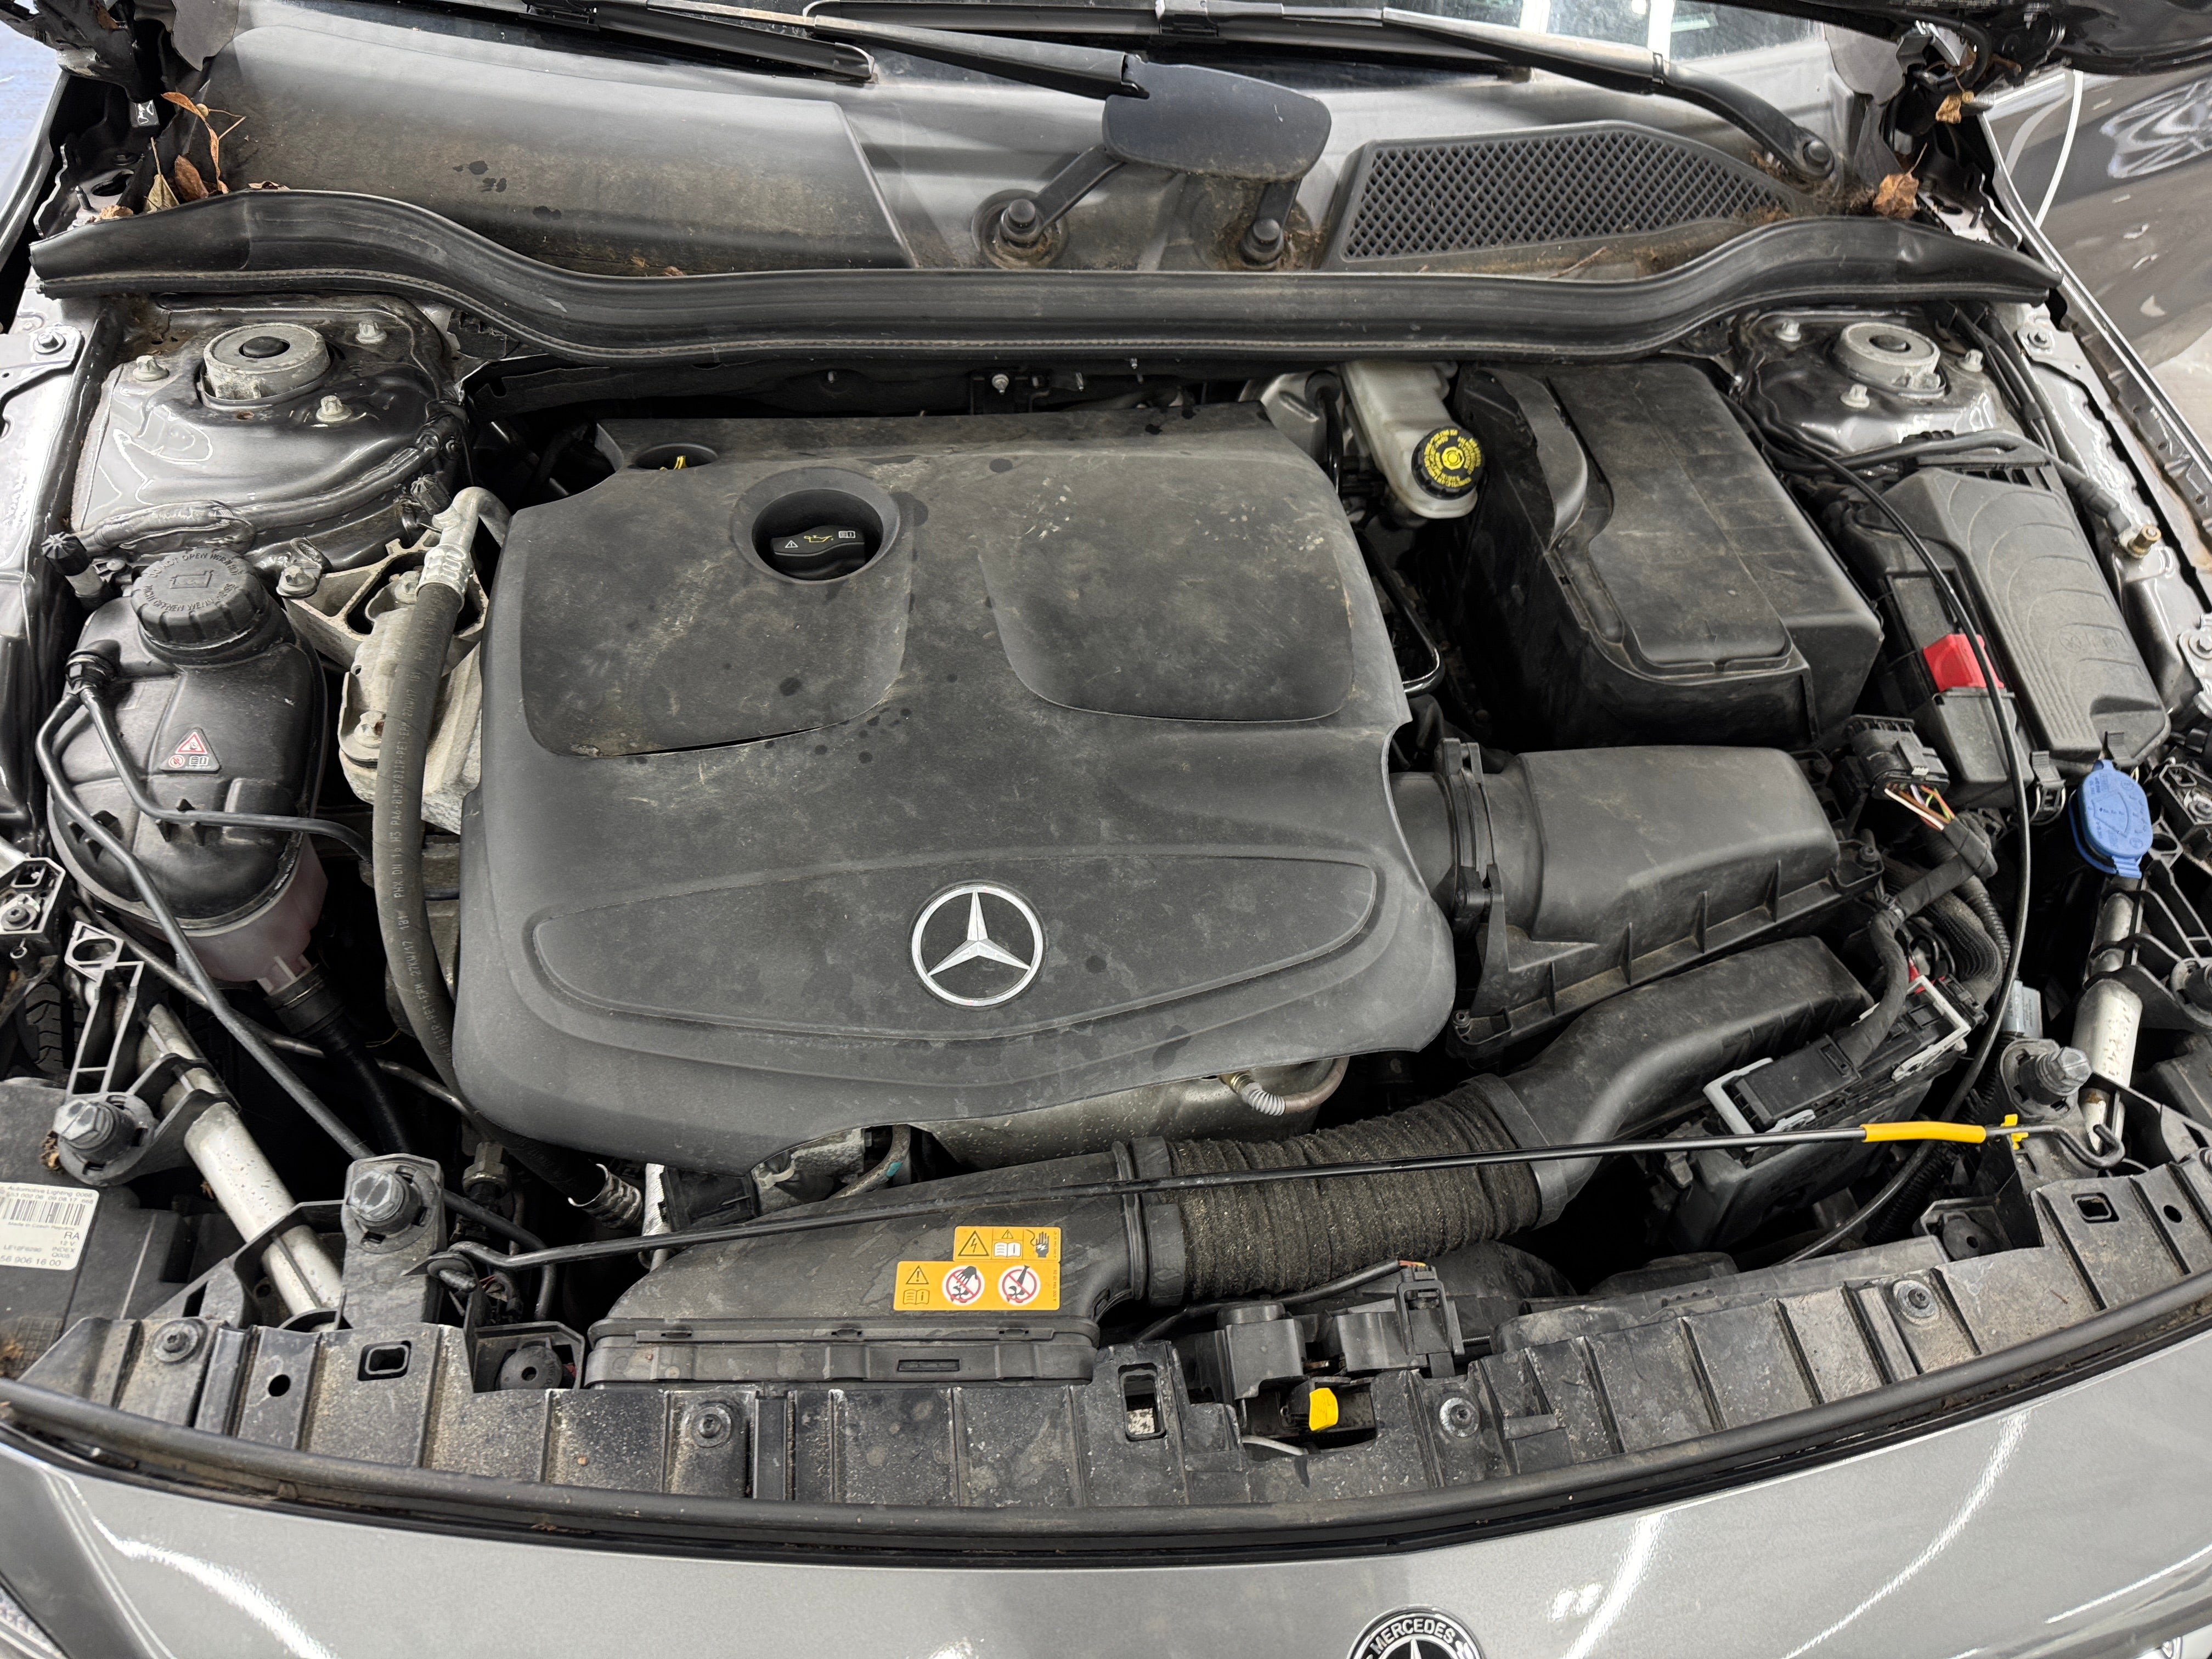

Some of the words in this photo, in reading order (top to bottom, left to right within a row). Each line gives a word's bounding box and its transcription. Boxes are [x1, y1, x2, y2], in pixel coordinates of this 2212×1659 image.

[148, 568, 162, 579] DO
[160, 557, 179, 571] NOT
[182, 552, 208, 561] OPEN
[390, 847, 403, 859] 16
[391, 864, 403, 876] DN
[393, 881, 405, 899] PHX
[47, 1189, 73, 1197] Lighting
[64, 1231, 80, 1240] RA
[1369, 1618, 1457, 1655] MERCEDES
